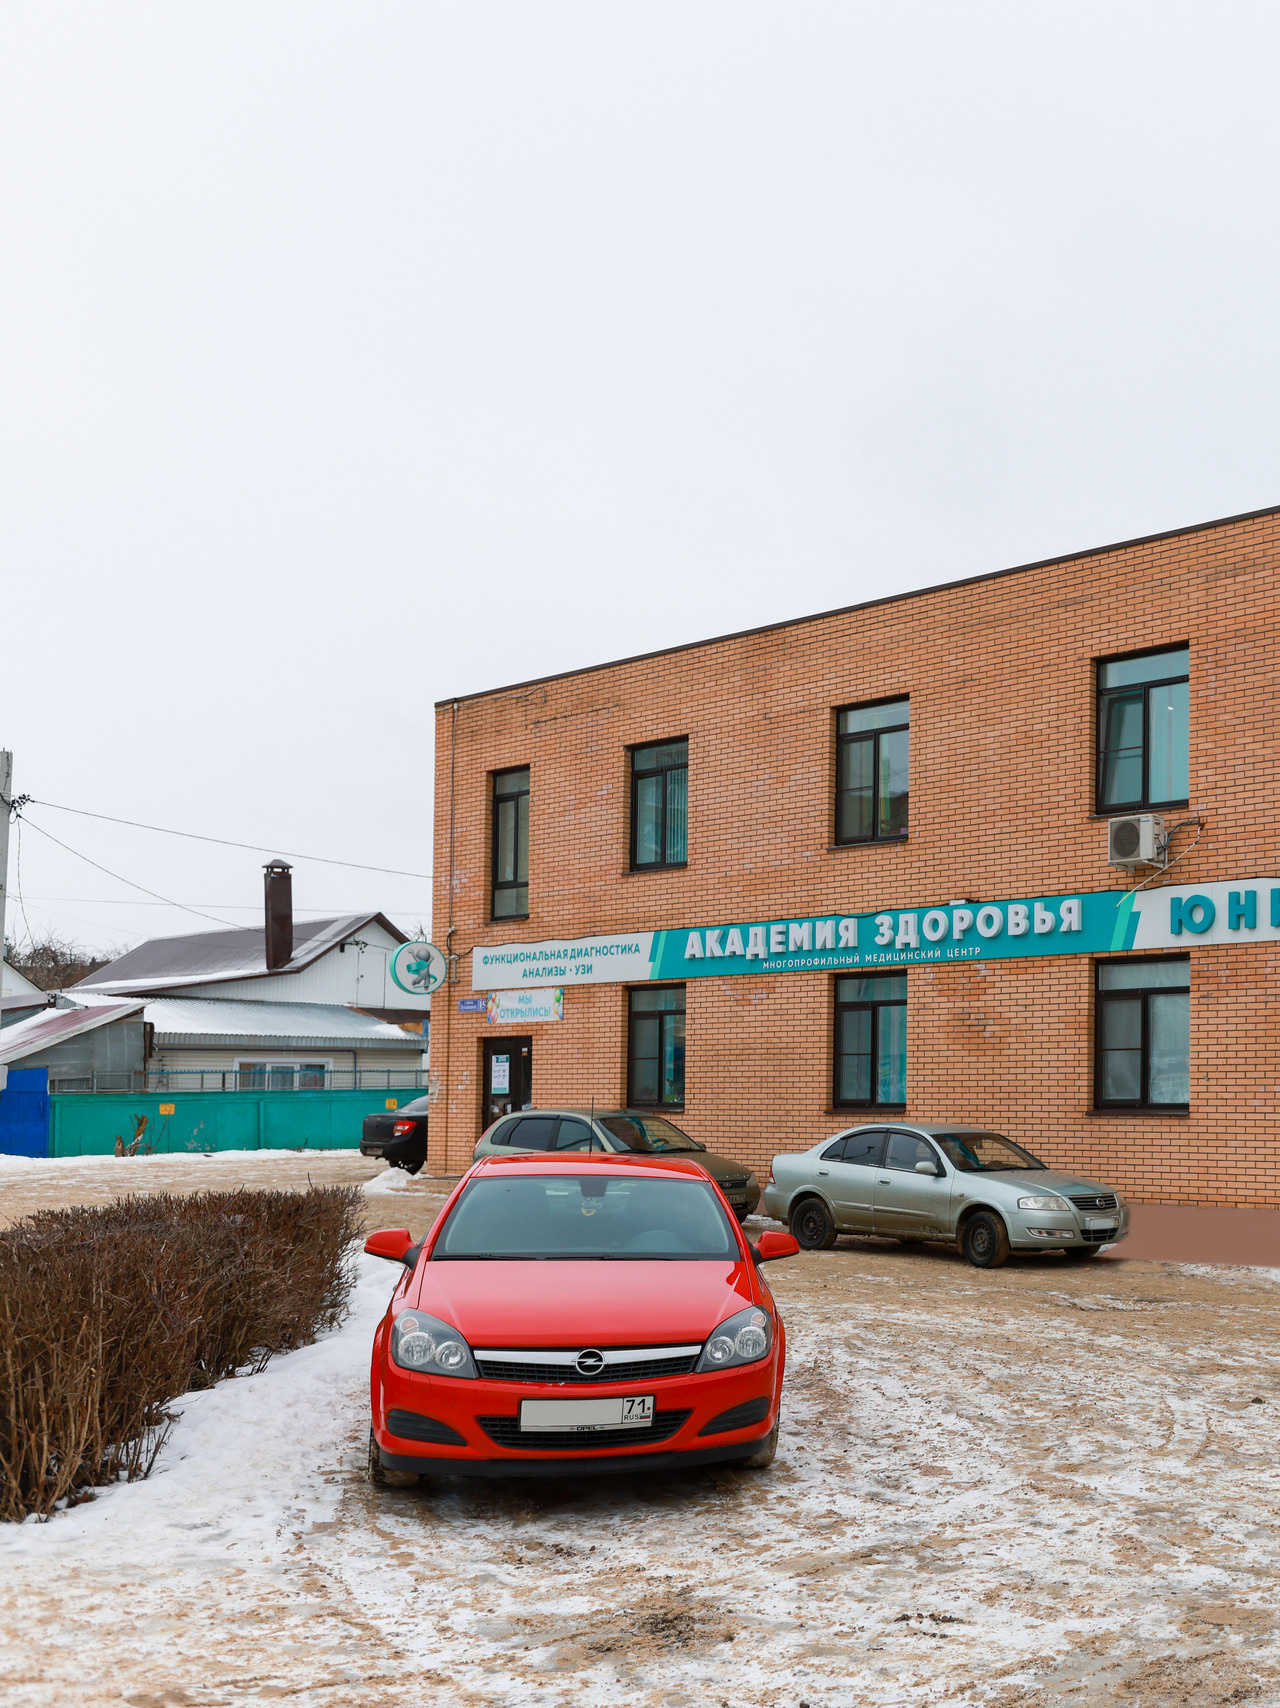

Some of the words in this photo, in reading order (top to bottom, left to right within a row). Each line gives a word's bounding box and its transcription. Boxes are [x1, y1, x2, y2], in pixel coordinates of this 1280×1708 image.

[684, 917, 858, 960] АКАДЕМИЯ
[874, 898, 1082, 950] ЗДОРОВЬЯ
[482, 948, 568, 966] ФУНКЦИОНАЛЬНАЯ
[569, 943, 641, 961] ДИАГНОСТИКА
[762, 953, 860, 969] МНОГОПРОФИЛЬНЫЙ
[865, 947, 941, 963] МЕДИЦИНСКИЙ
[946, 946, 981, 958] ЦЕНТР
[522, 966, 567, 979] АНАЛИЗЫ
[574, 964, 593, 976] УЗИ
[479, 1000, 486, 1010] 15
[518, 994, 532, 1005] МЫ
[499, 1005, 551, 1019] ОТКРЫЛИСЬ!
[625, 1399, 647, 1415] 71
[624, 1413, 640, 1421] RUS
